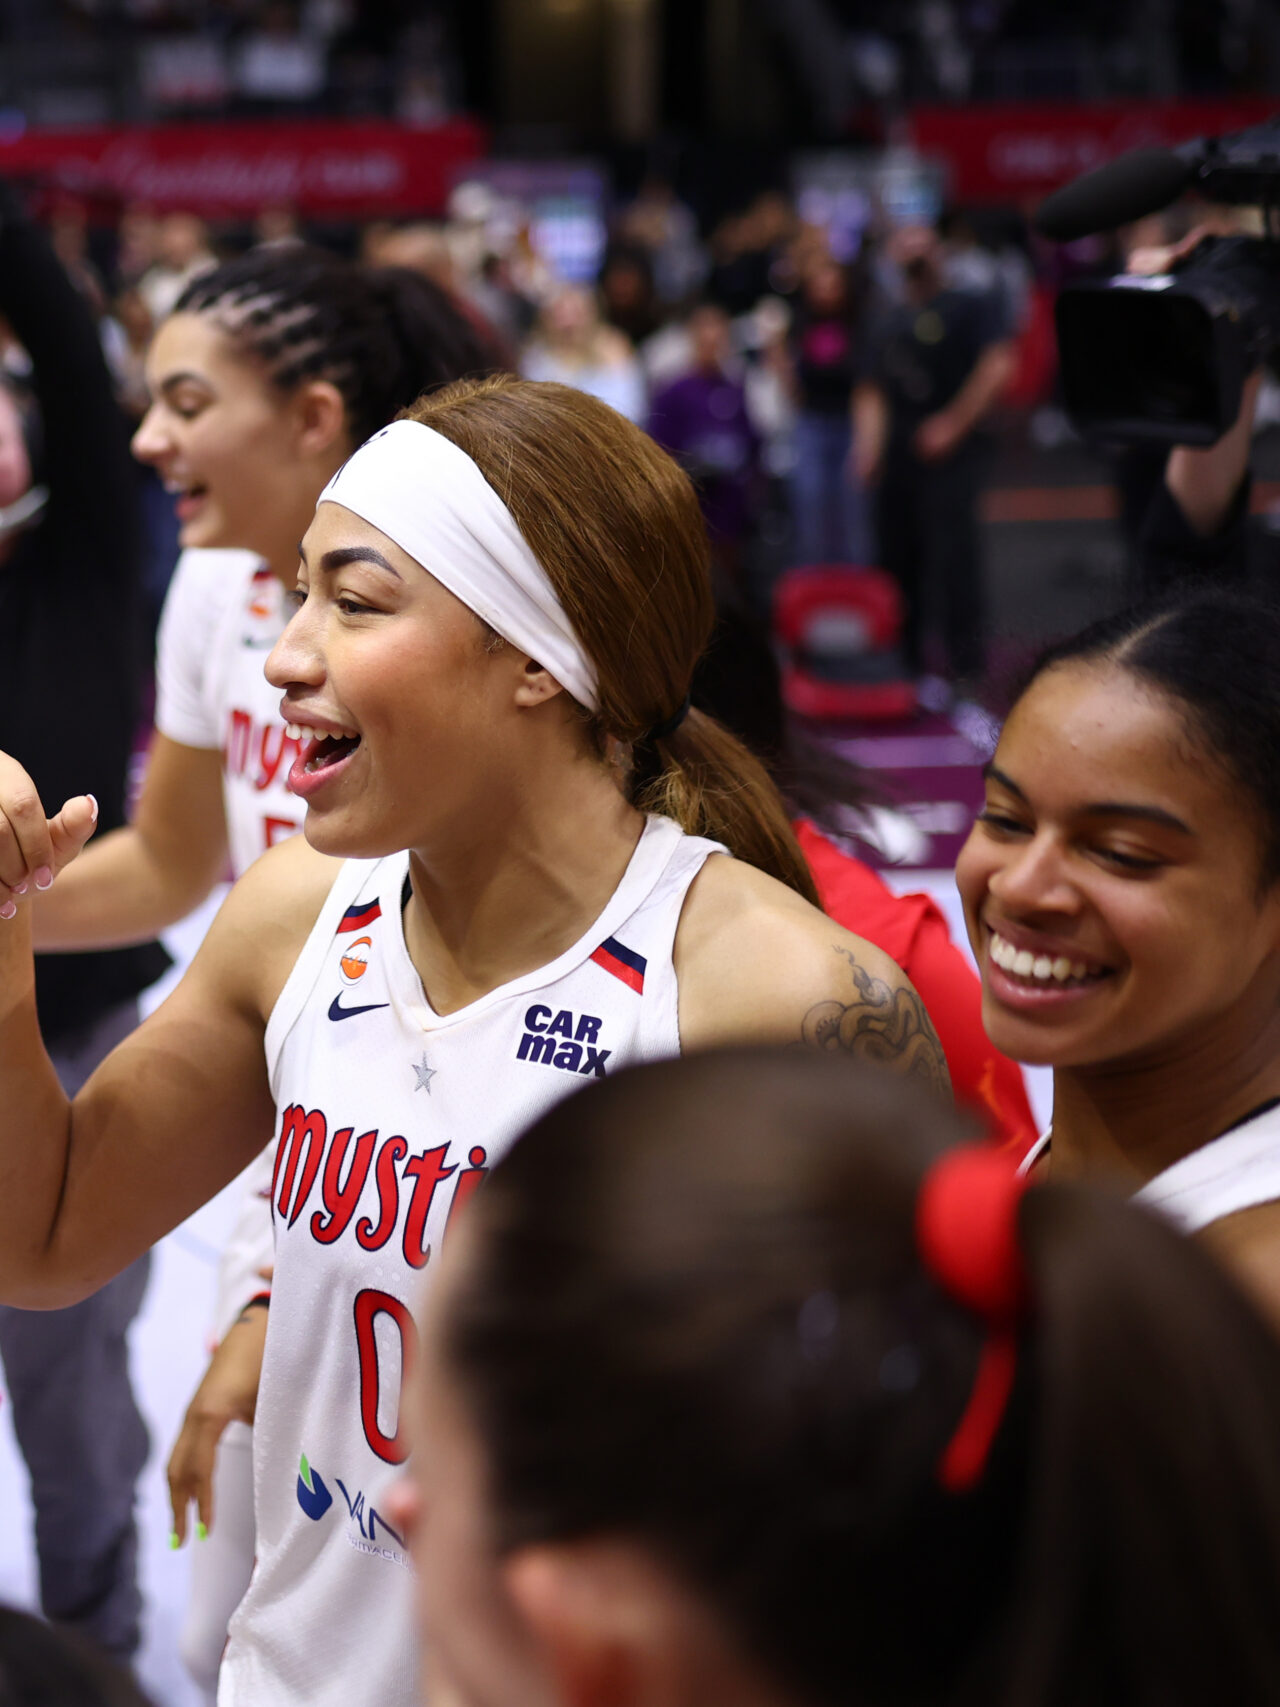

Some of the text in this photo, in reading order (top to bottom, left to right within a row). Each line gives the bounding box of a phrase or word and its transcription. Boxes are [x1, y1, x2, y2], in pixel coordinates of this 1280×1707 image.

[524, 1004, 603, 1045] CAR
[516, 1032, 613, 1080] max
[335, 1478, 408, 1551] VAN
